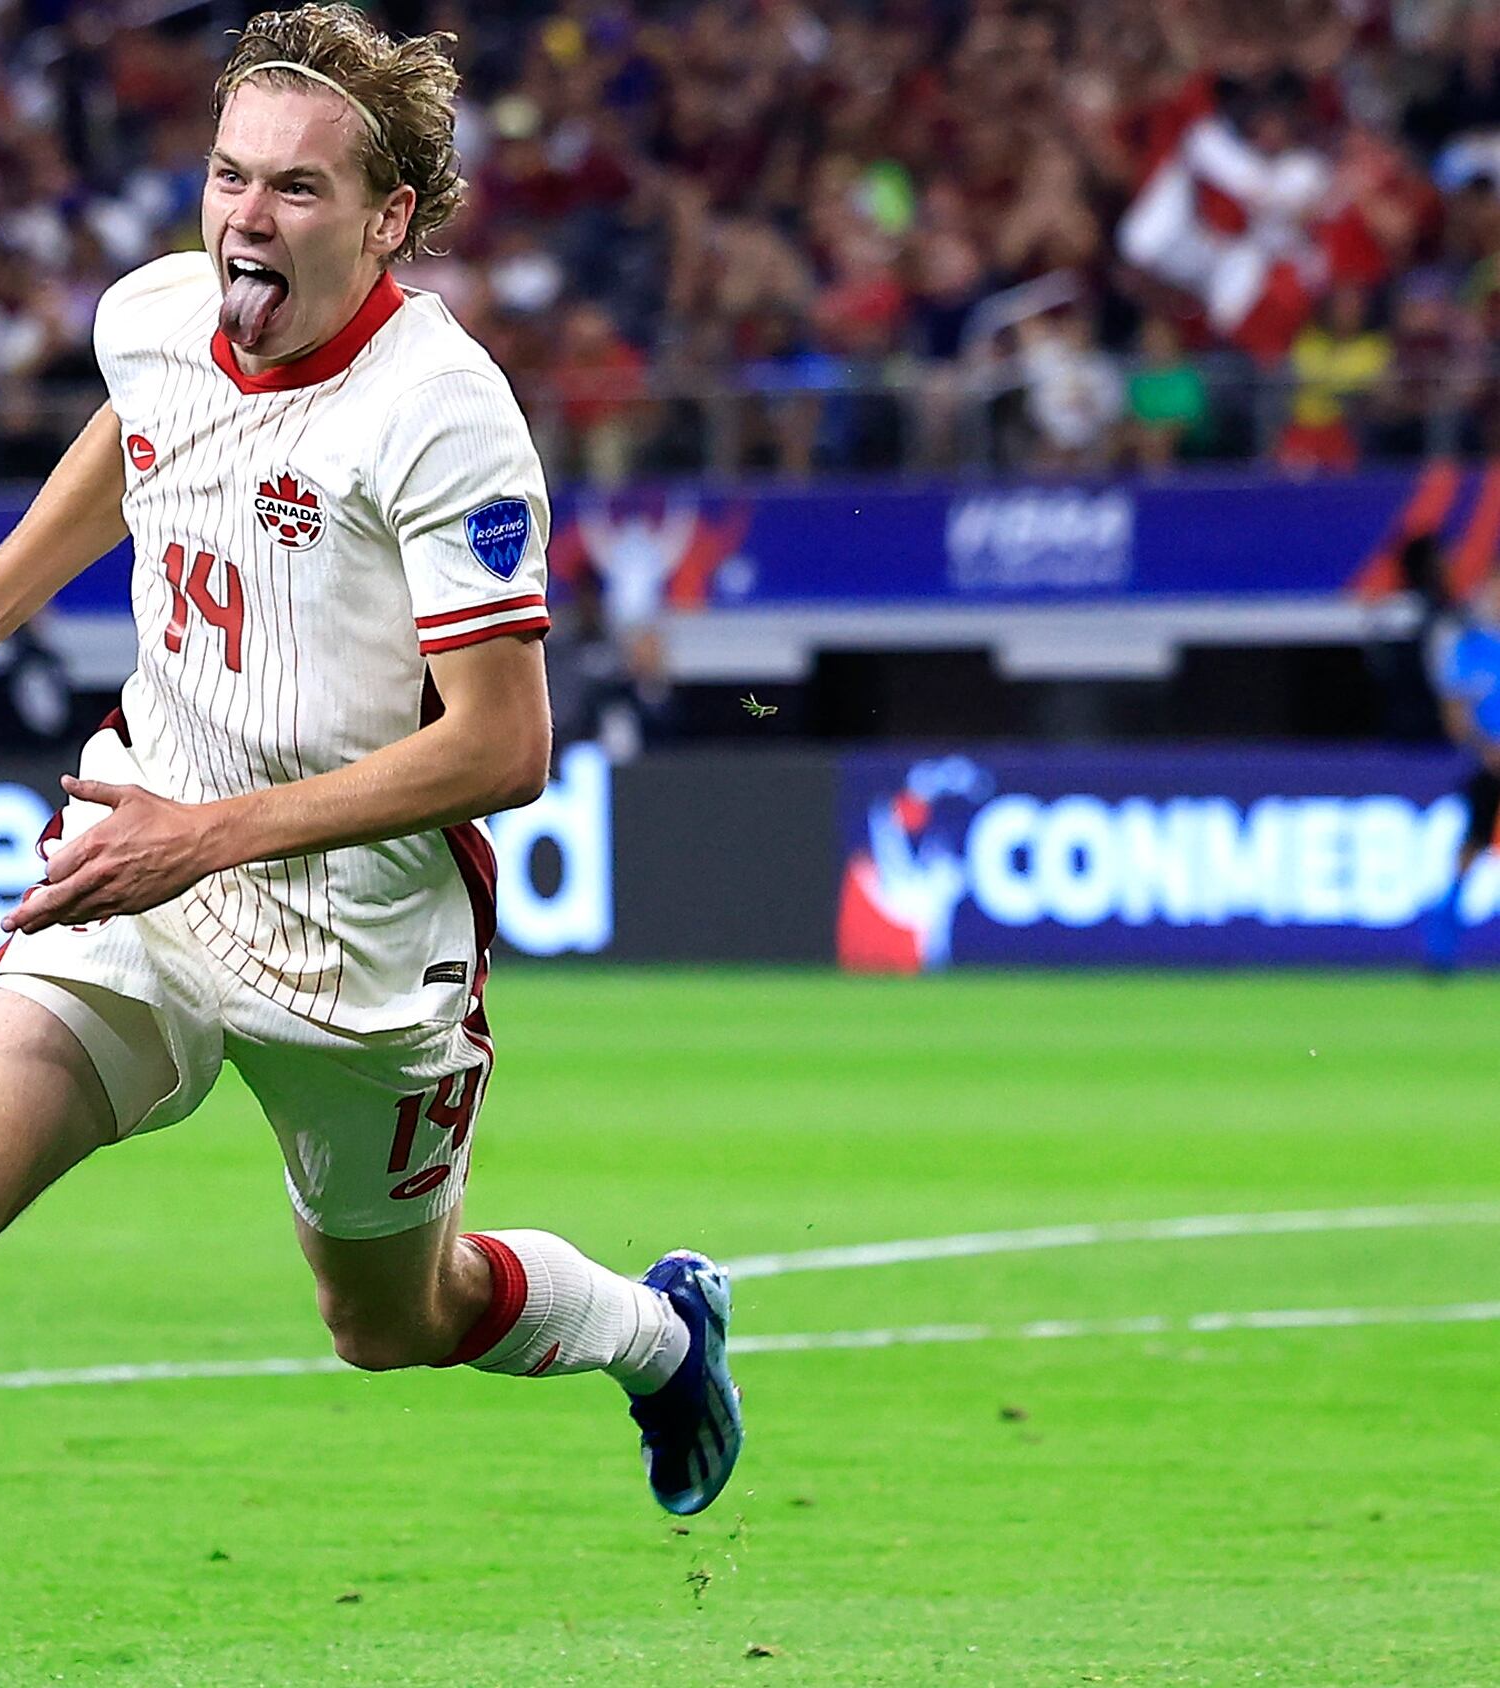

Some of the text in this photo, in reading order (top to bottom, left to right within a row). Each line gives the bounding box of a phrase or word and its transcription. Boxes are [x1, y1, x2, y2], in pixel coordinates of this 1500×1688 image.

[254, 498, 322, 524] CANADA
[476, 518, 525, 540] ROCKING
[162, 541, 245, 674] 14
[387, 1062, 483, 1174] 14
